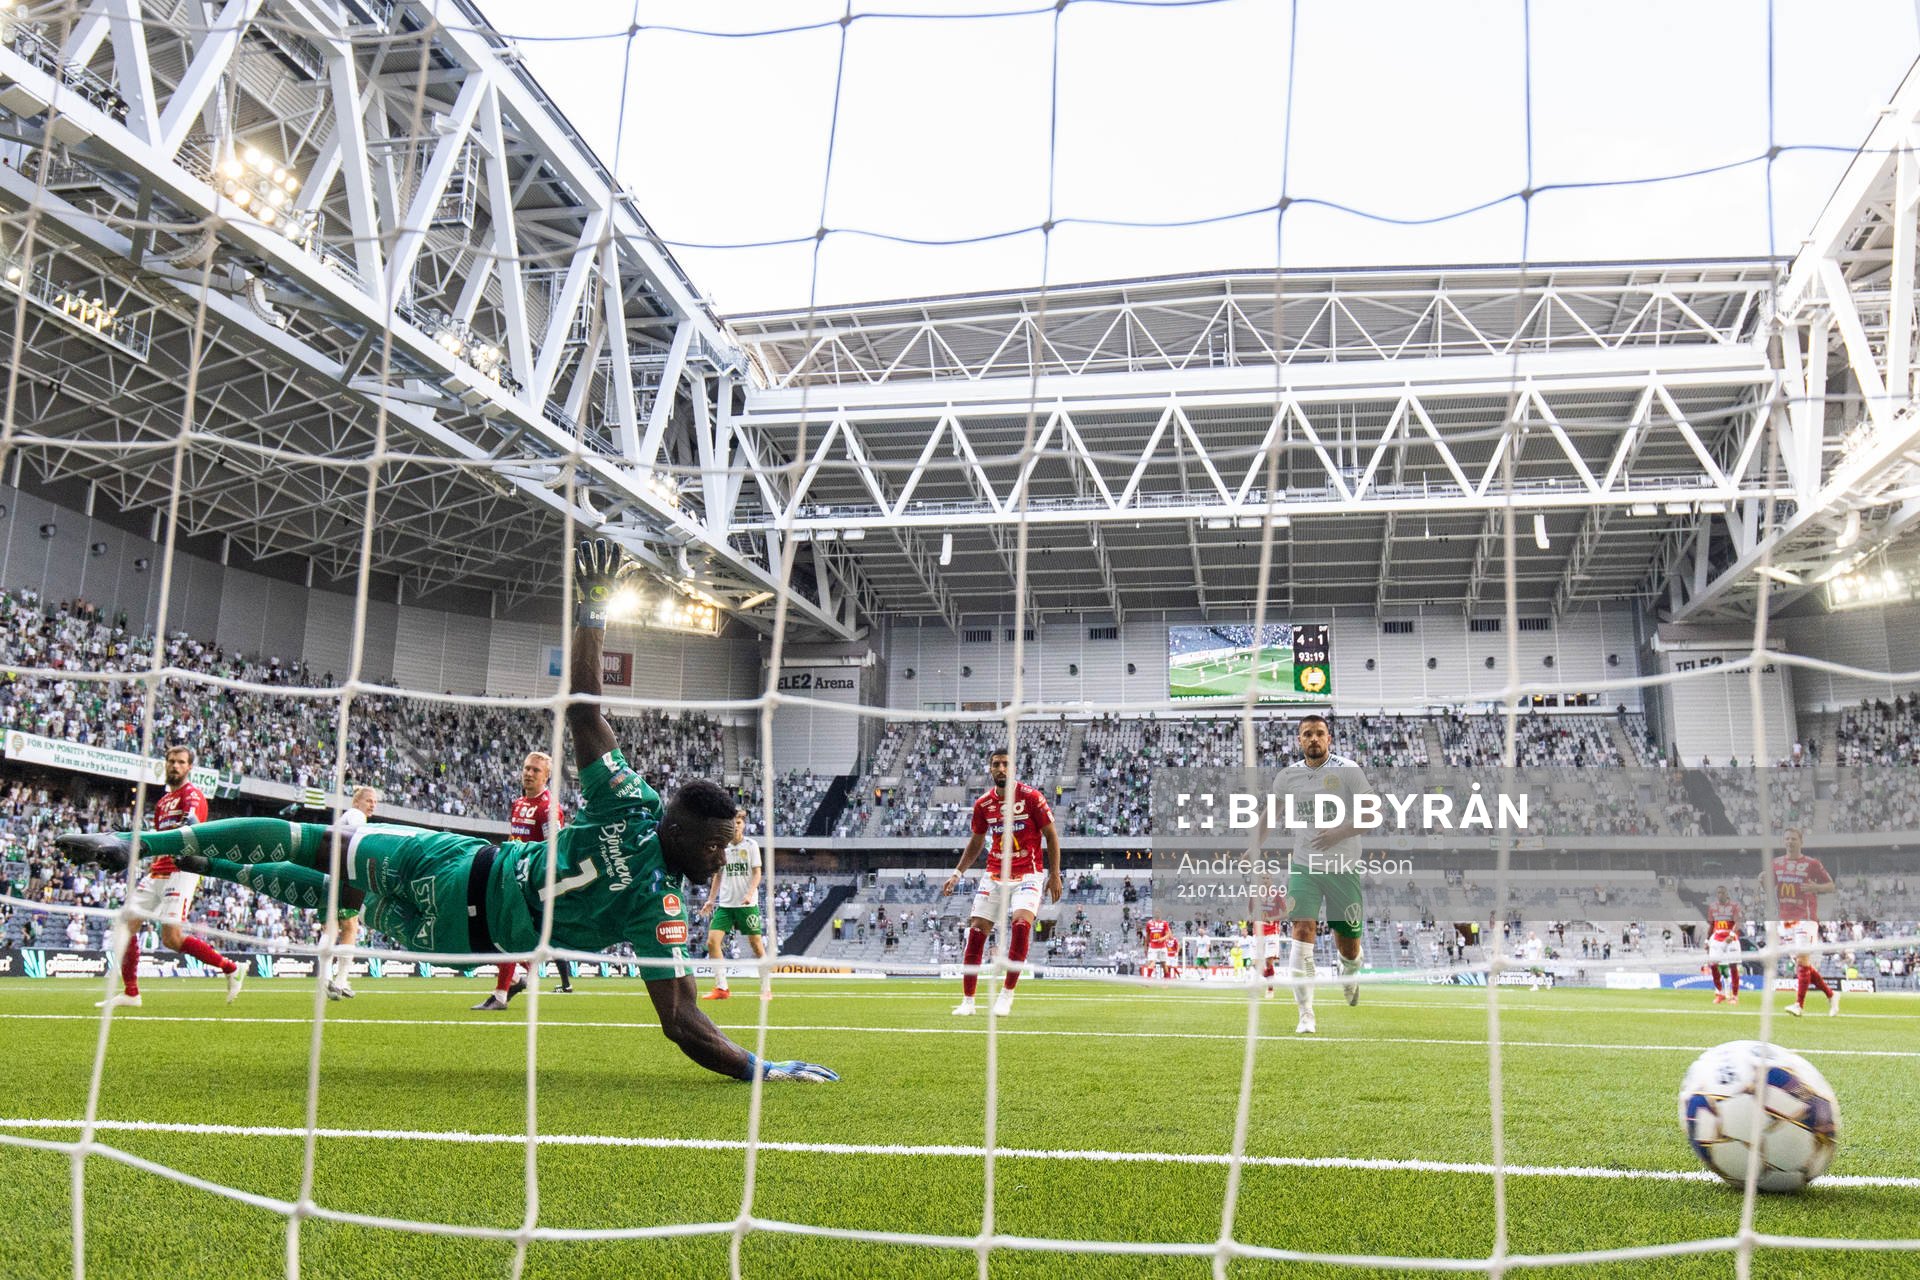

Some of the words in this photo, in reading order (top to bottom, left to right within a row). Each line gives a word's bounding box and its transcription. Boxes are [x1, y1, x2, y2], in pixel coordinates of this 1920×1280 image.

[1297, 634, 1305, 646] 4
[1317, 634, 1323, 645] 1
[602, 656, 621, 671] OB
[1298, 652, 1325, 662] 93:19
[777, 673, 812, 690] ELE2
[814, 677, 855, 689] Arena
[56, 743, 85, 756] POSITIV
[53, 754, 128, 775] Hammarbyklanen
[187, 772, 217, 787] ATCH
[659, 926, 686, 936] UNIBET
[696, 966, 732, 974] CRT
